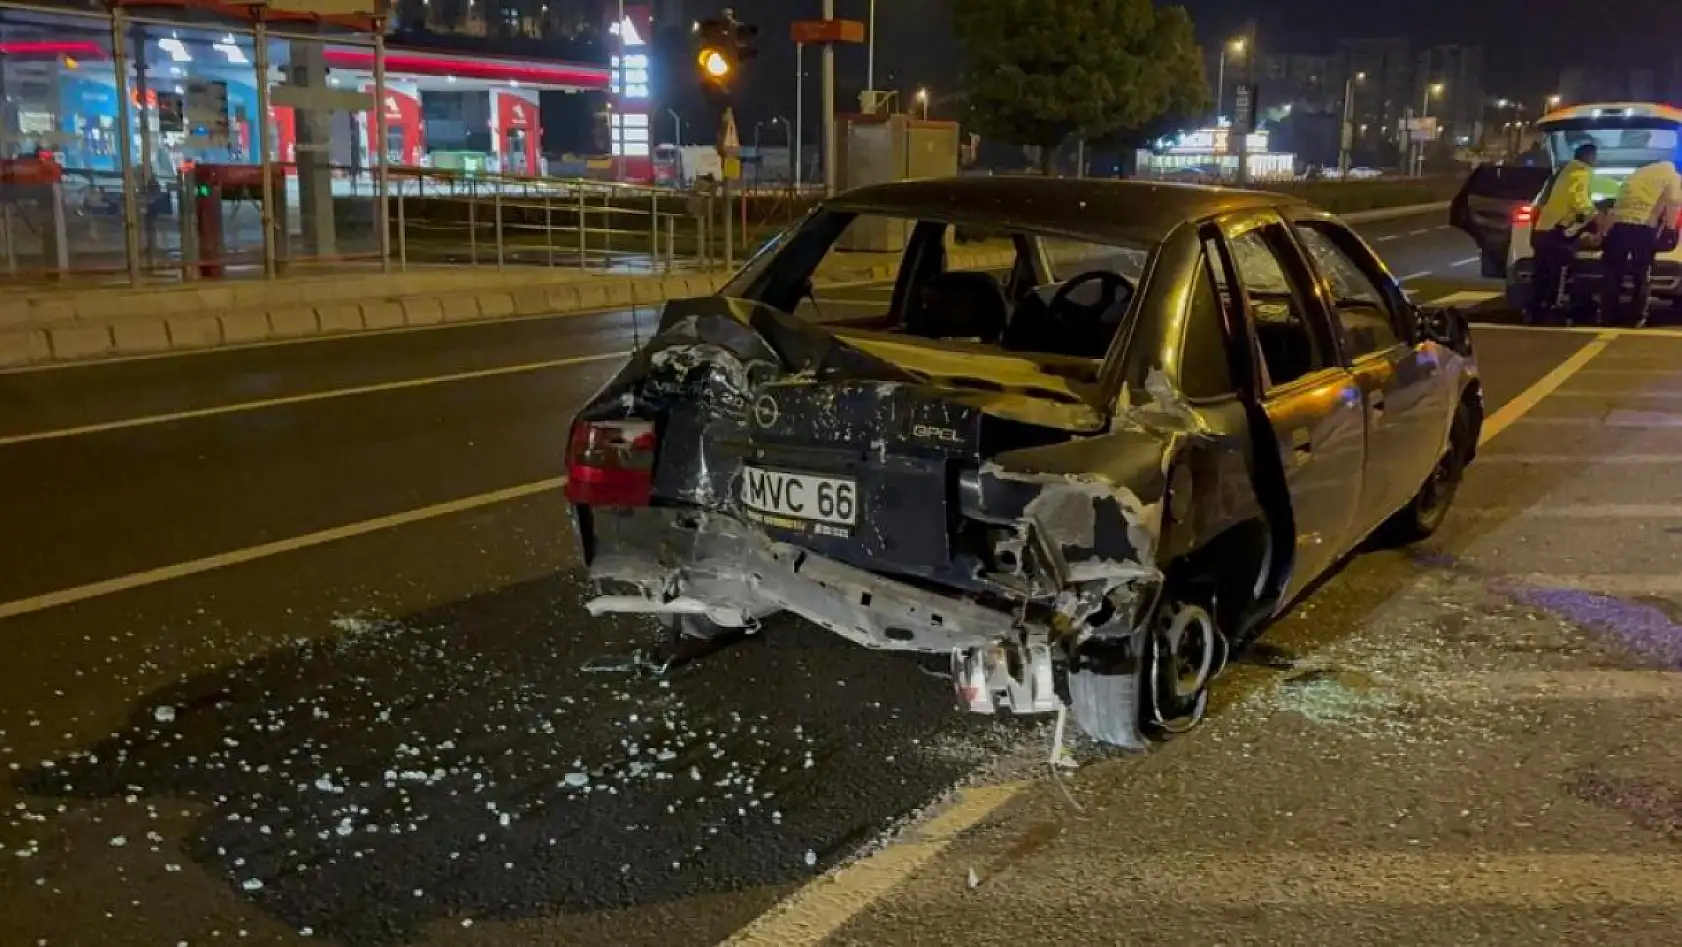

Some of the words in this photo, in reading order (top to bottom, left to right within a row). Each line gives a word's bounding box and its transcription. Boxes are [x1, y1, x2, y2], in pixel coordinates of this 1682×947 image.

[913, 424, 965, 441] OPEL
[748, 471, 804, 512] MVC
[817, 481, 852, 519] 66
